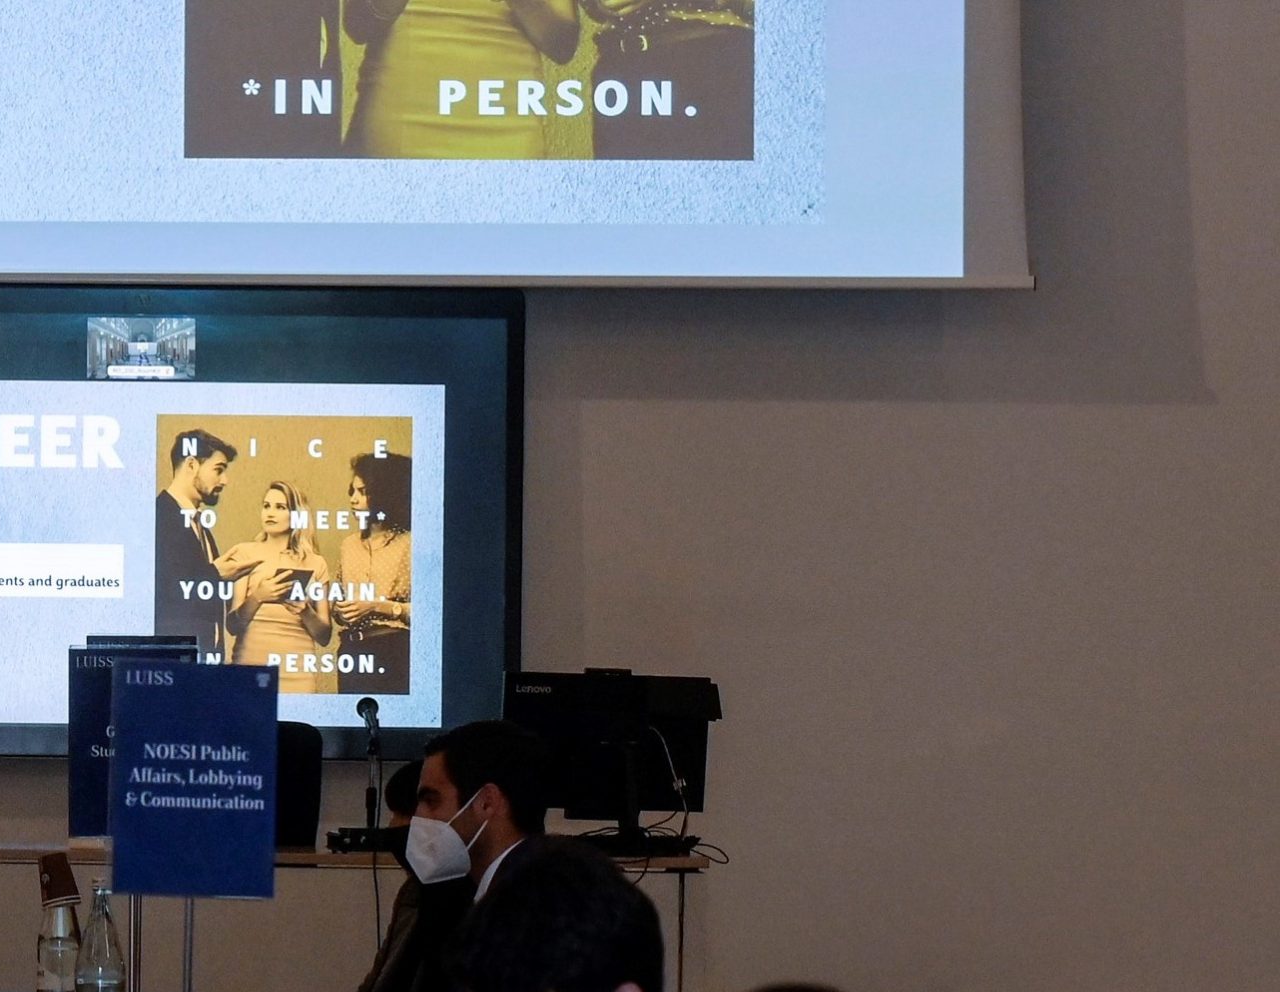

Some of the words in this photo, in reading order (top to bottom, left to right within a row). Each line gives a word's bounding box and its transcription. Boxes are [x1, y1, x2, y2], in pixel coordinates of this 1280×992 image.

[438, 79, 699, 117] PERSON.
[180, 510, 217, 528] TO
[28, 575, 53, 587] and
[56, 576, 120, 590] graduates
[179, 581, 234, 600] YOU
[290, 582, 387, 601] AGAIN.
[76, 655, 115, 668] LUISS
[267, 653, 386, 674] PERSON.
[126, 669, 175, 686] LUISS
[515, 683, 552, 694] Lenovo
[143, 743, 197, 760] NOESI
[200, 745, 250, 762] Public
[129, 767, 186, 785] Affairs,
[189, 769, 263, 790] Lobbying
[125, 791, 138, 807] &
[140, 791, 265, 810] Communication
